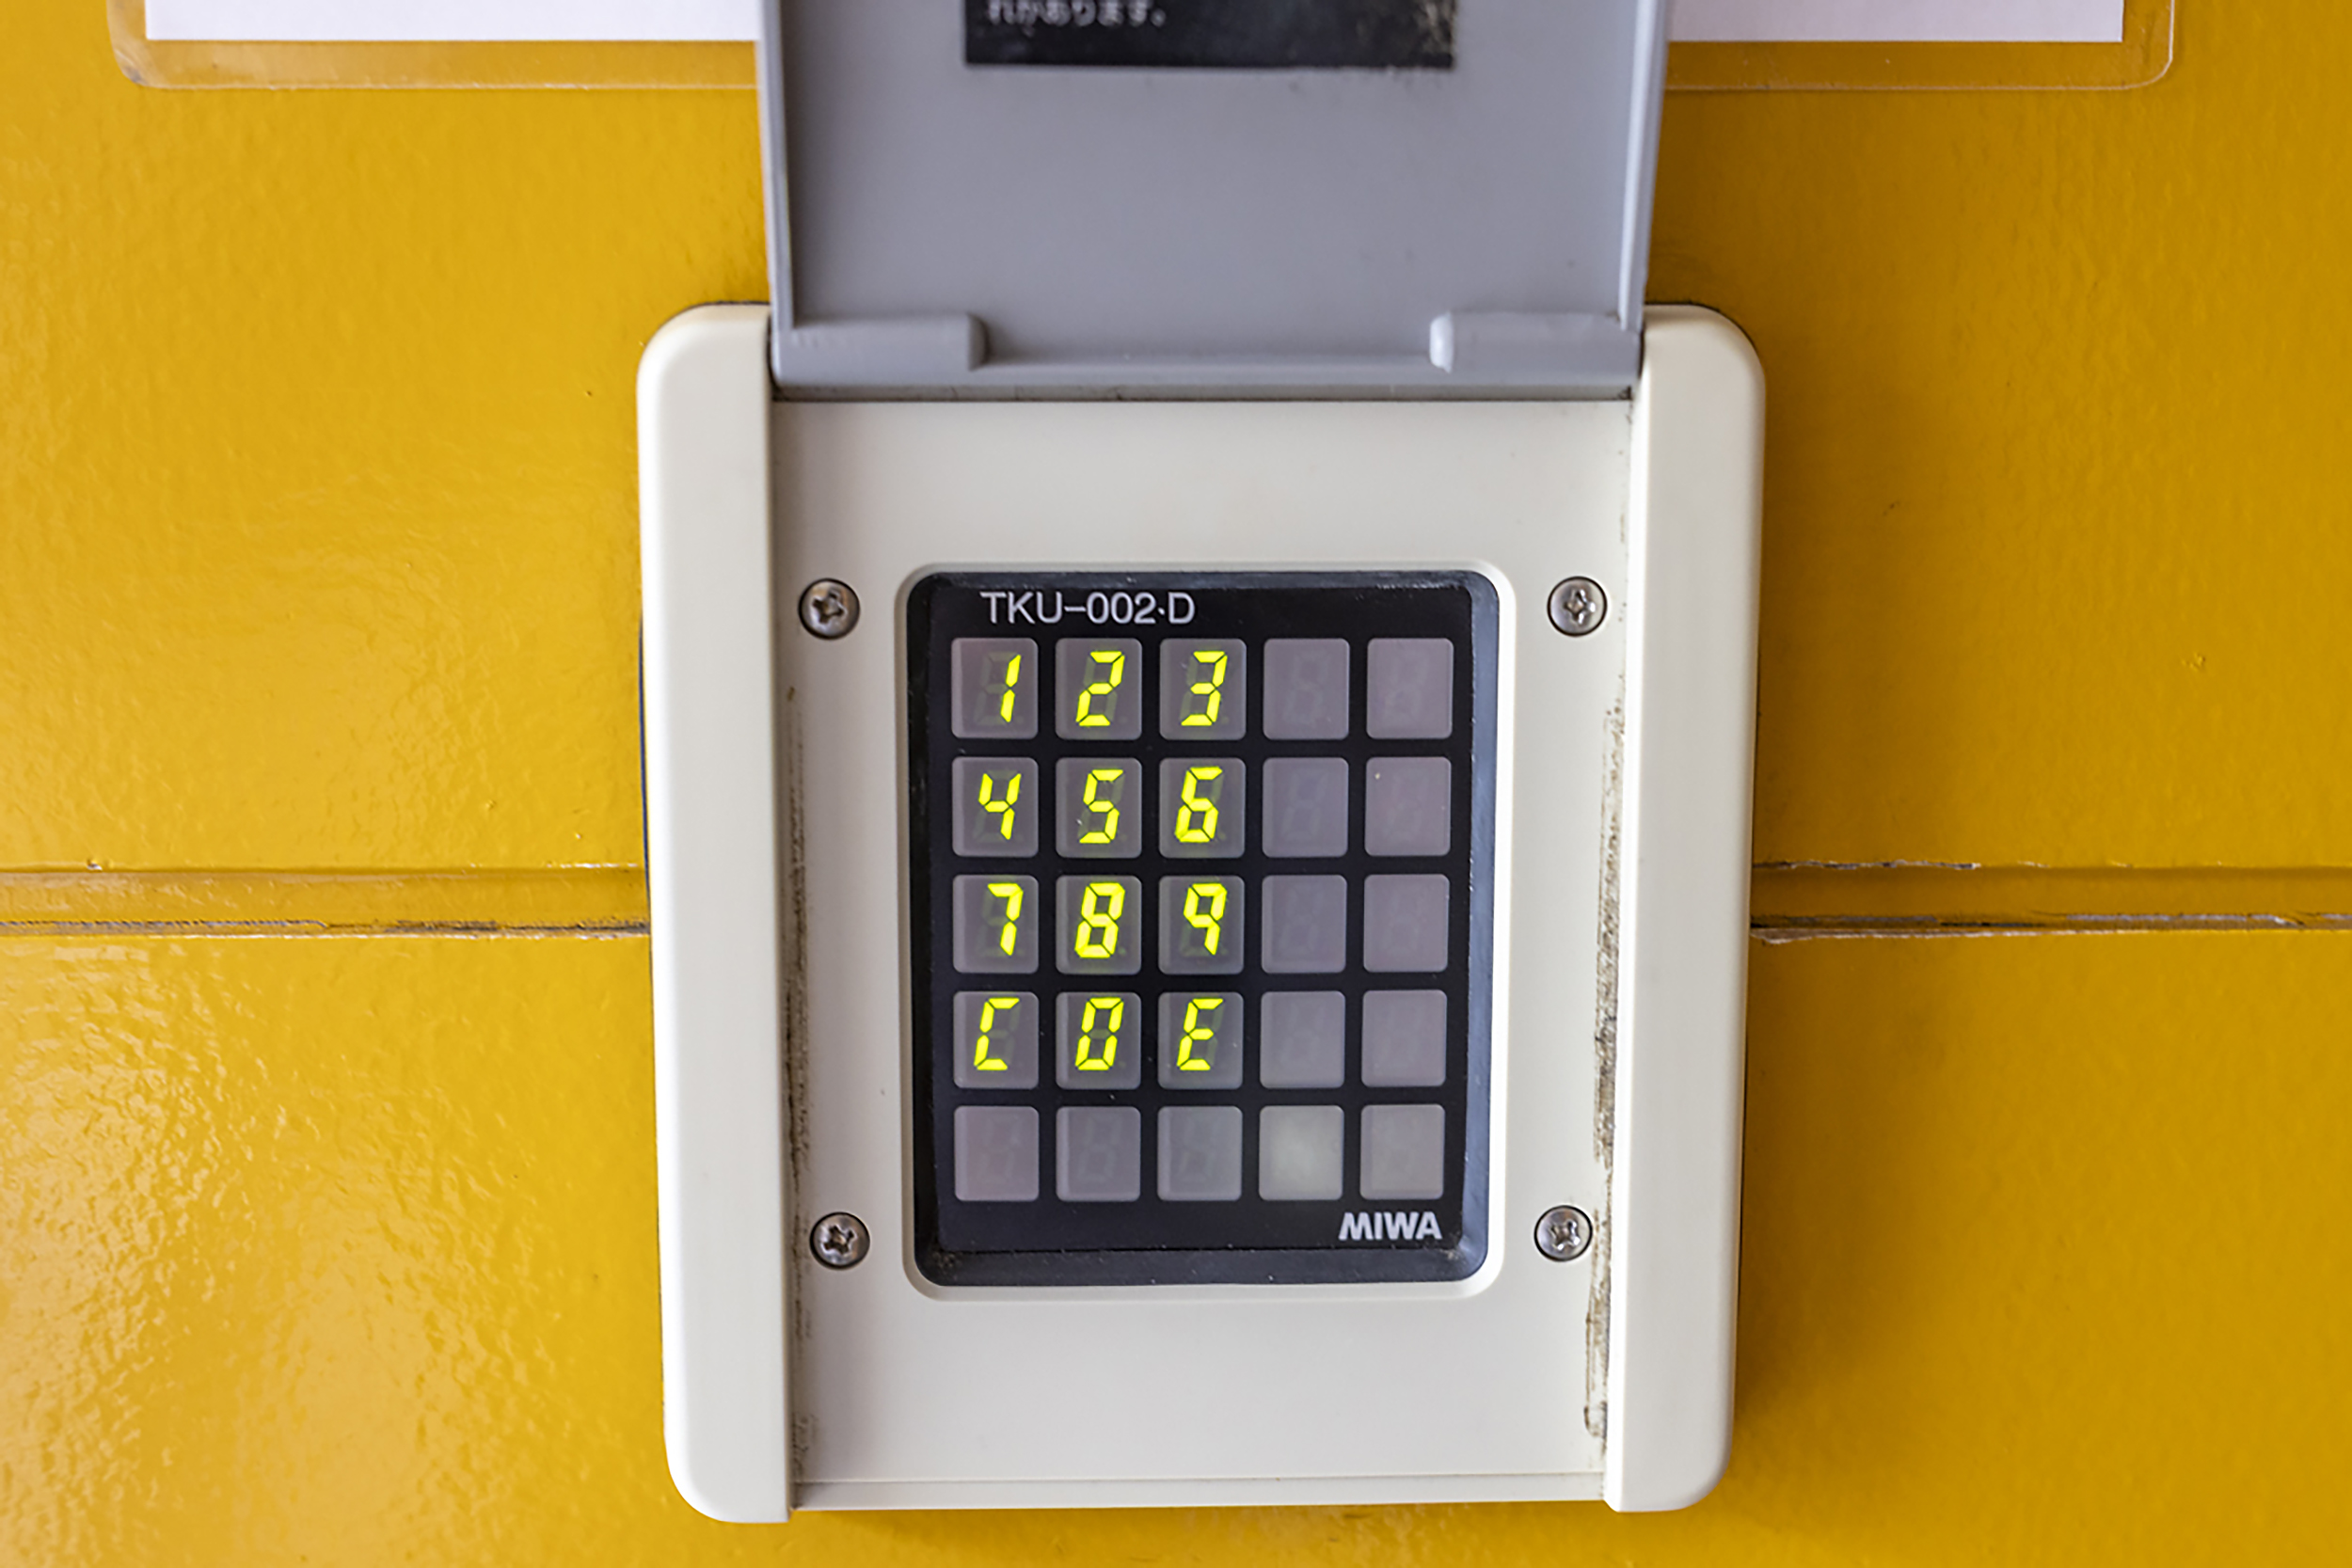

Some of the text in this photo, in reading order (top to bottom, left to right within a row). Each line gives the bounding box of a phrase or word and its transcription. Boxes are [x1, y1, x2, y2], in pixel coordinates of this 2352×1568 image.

[1000, 651, 1228, 726] 1 2 3
[978, 767, 1222, 844] 4 5 6
[988, 882, 1227, 958] 7 8 9
[974, 997, 1223, 1070] C 0 E
[1338, 1212, 1442, 1241] MIWA
